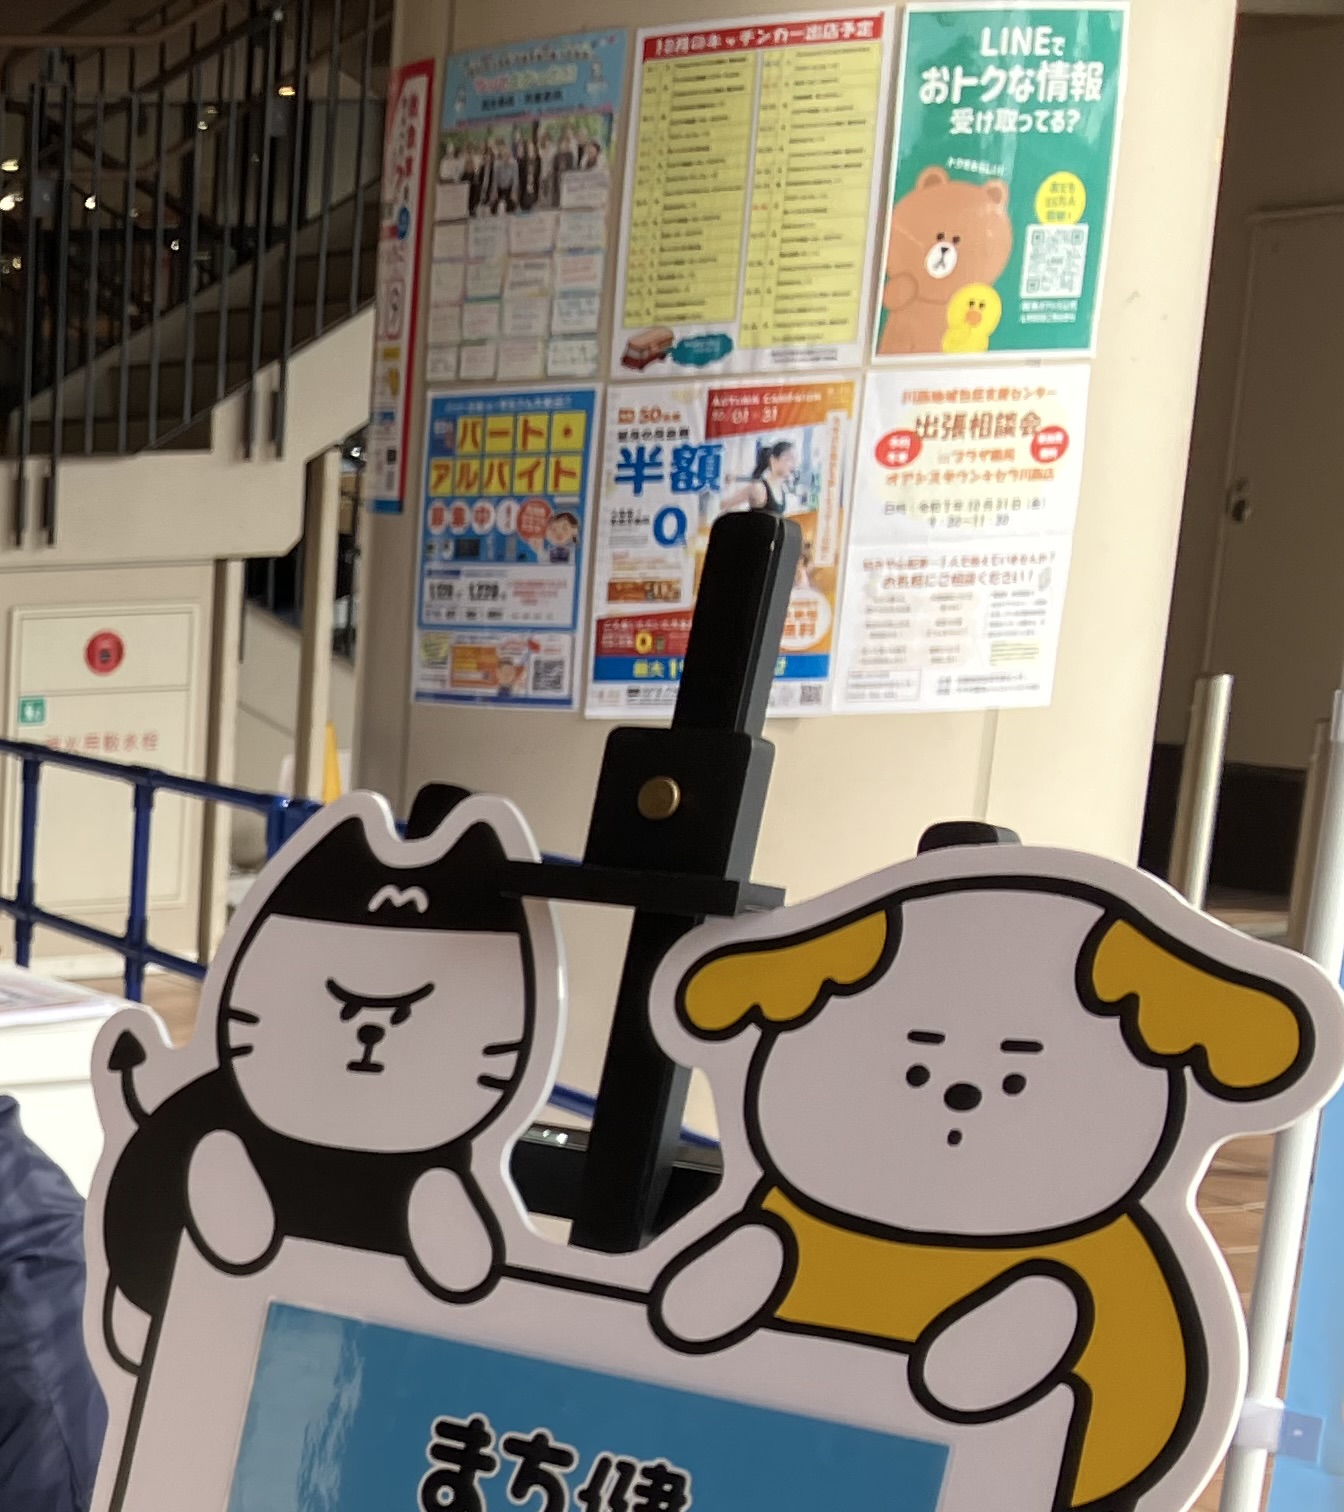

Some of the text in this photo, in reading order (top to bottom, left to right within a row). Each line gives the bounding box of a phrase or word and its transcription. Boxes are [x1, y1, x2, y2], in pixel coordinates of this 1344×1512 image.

[979, 25, 1066, 57] LINEで
[918, 60, 1105, 104] おトクな情報
[615, 444, 724, 497] 半額
